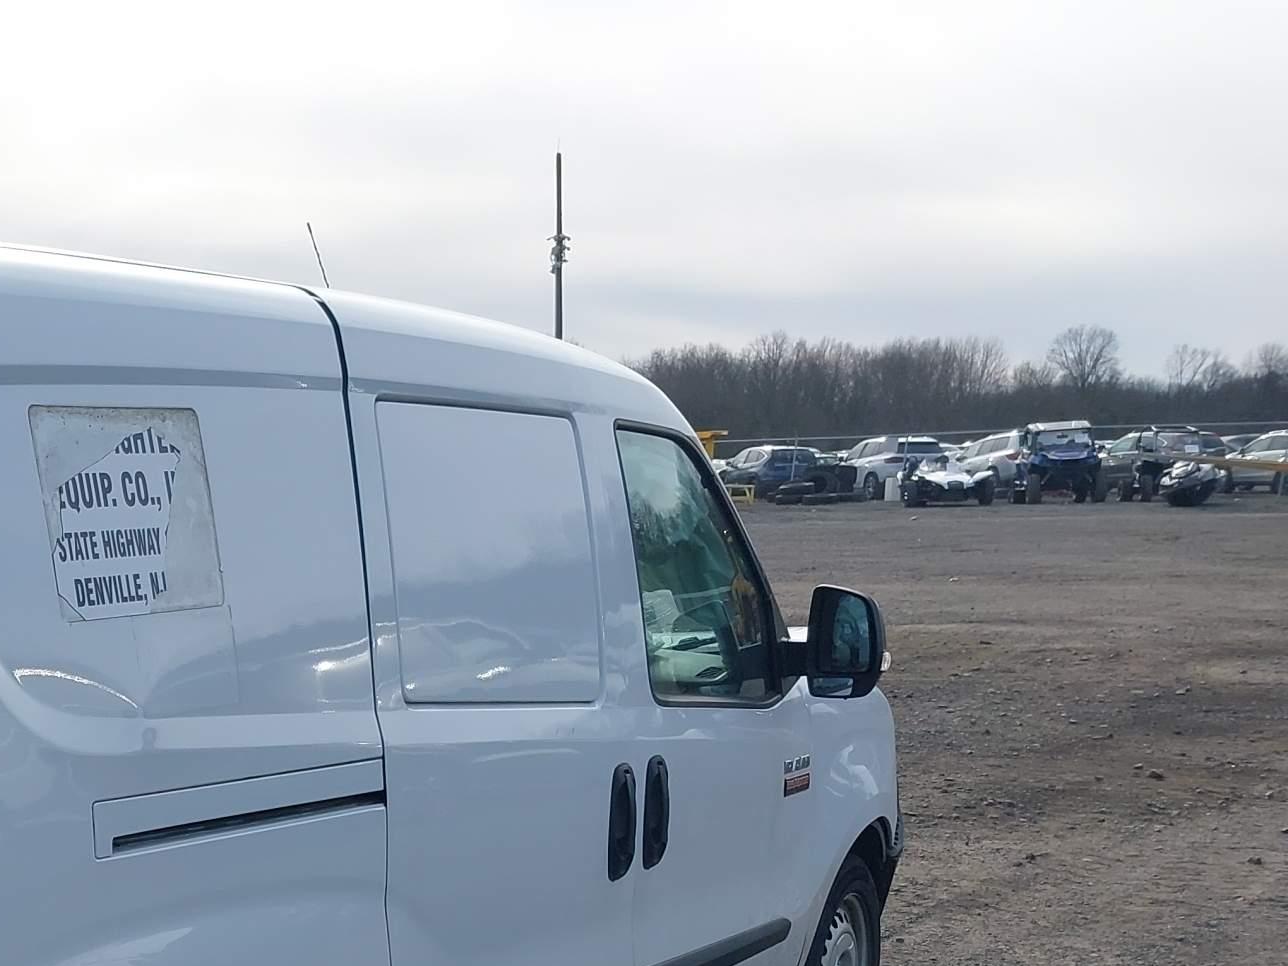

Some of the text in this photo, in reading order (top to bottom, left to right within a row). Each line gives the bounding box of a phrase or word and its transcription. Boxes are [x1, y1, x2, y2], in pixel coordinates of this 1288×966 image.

[120, 470, 162, 512] CO.,
[58, 527, 161, 562] STATE HIGHWAY
[74, 573, 149, 608] DENVILLE,
